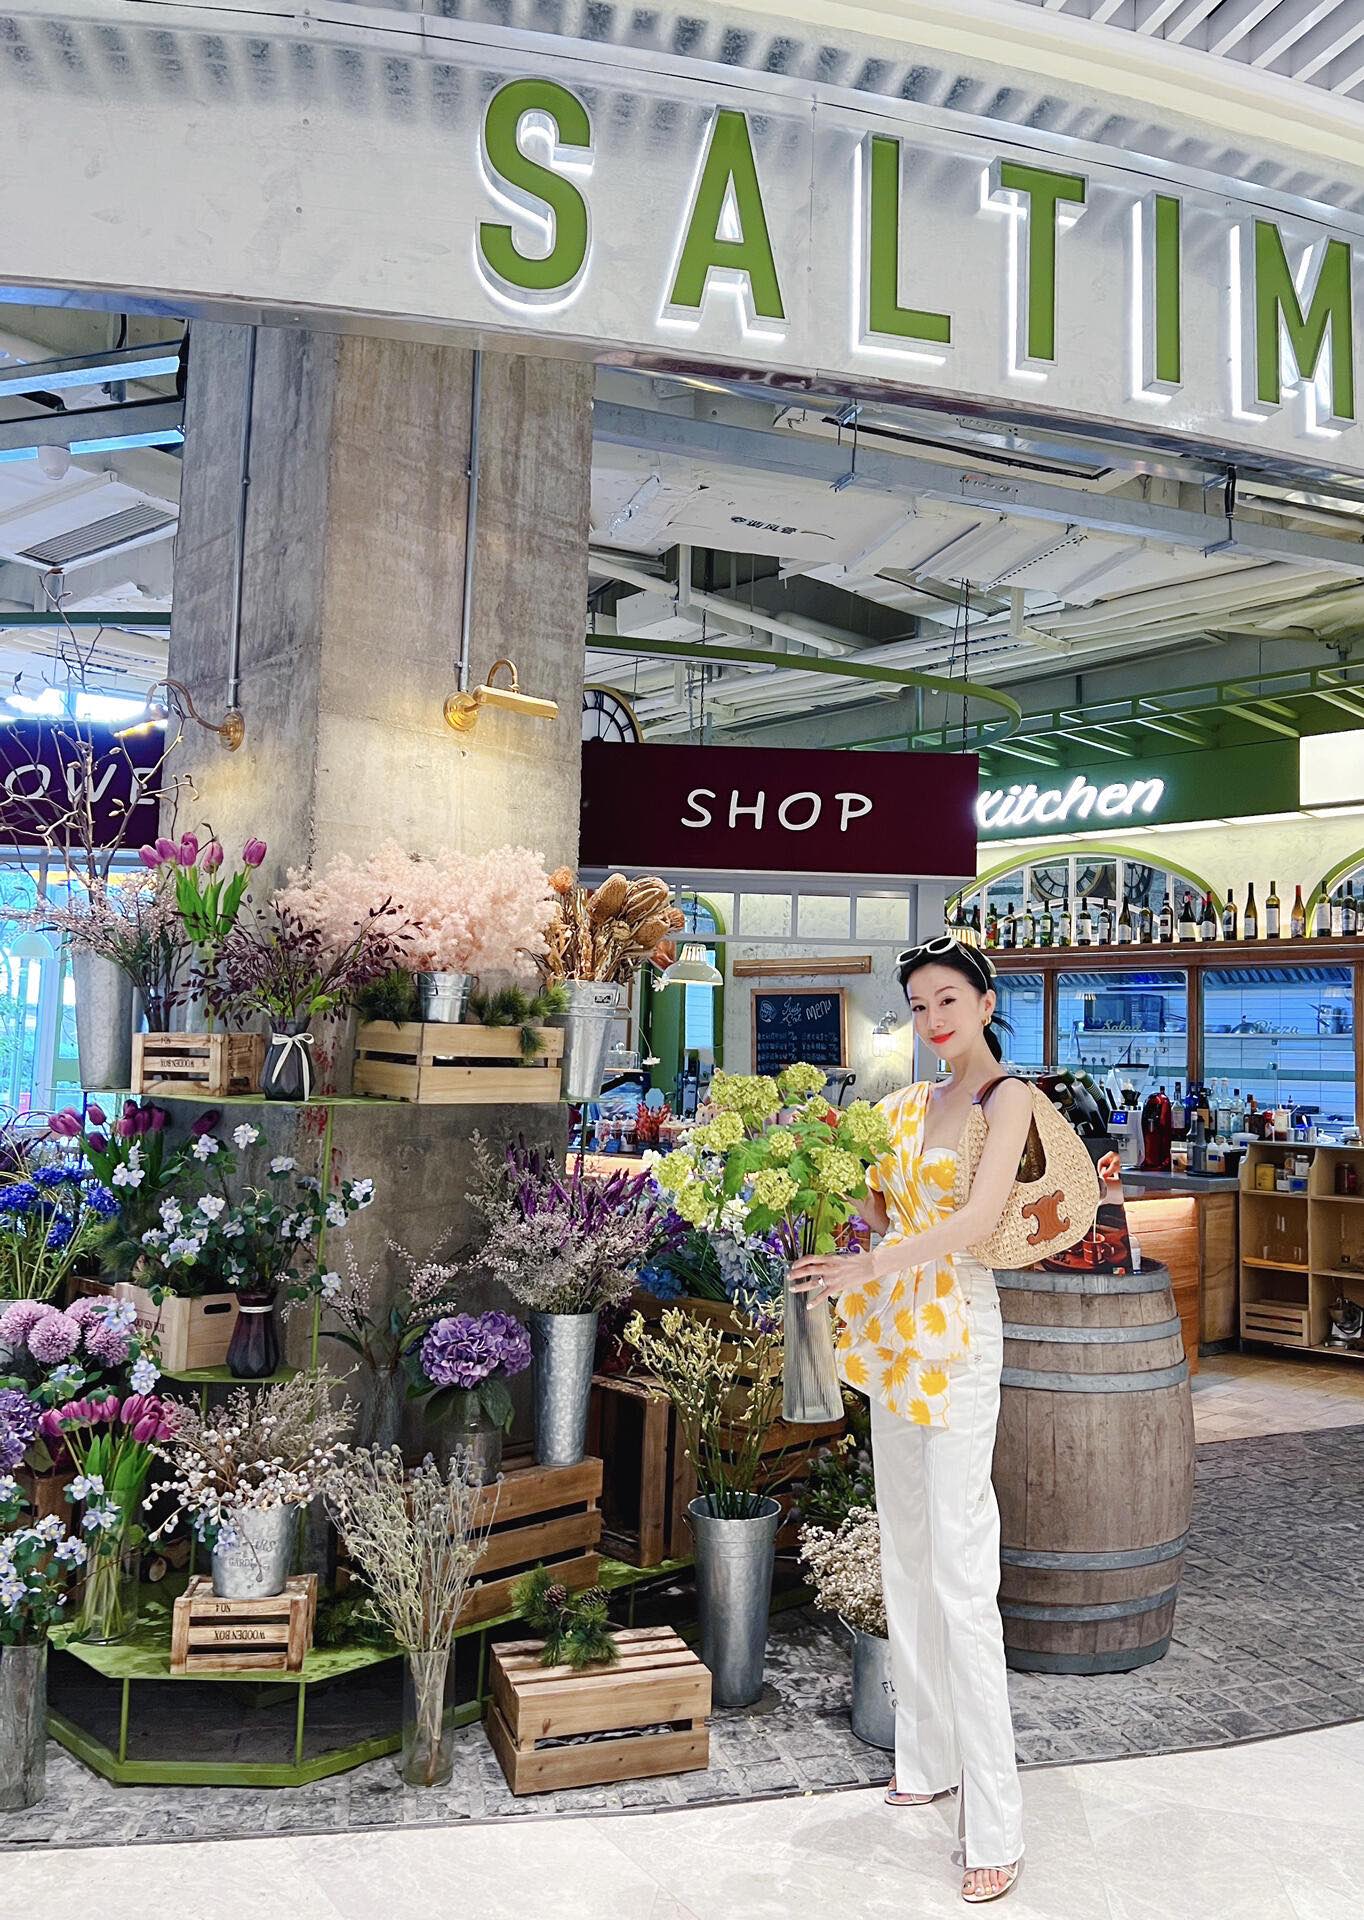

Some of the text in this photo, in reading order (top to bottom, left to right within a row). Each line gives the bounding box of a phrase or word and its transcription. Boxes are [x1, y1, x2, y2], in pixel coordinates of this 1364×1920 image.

[478, 78, 1353, 422] SALTIM
[681, 789, 873, 831] SHOP
[214, 1629, 266, 1640] WOODEN BOX
